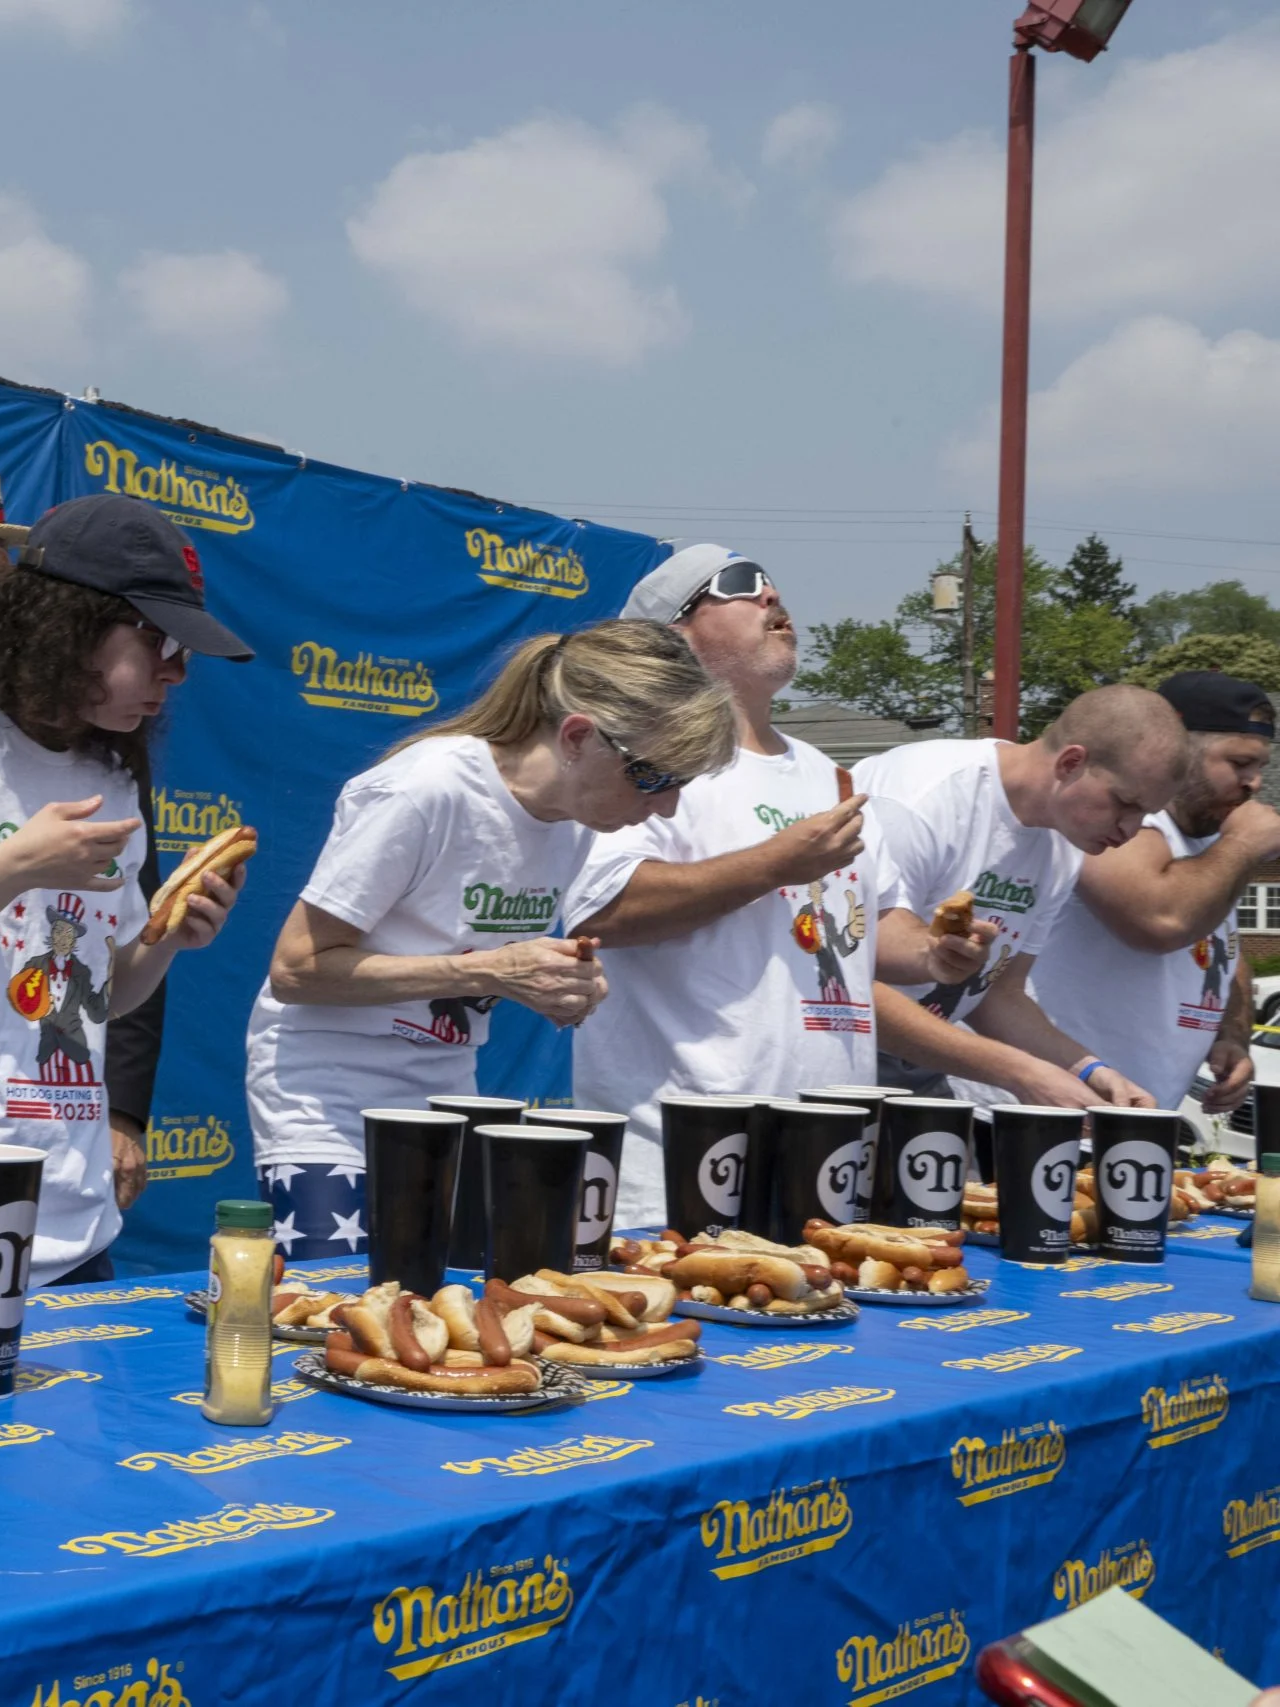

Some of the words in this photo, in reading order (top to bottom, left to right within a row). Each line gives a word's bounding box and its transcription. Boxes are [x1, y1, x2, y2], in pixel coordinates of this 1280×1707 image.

[85, 440, 248, 520] Nathan's
[465, 528, 585, 586] Nathan's
[291, 641, 434, 702] Nathan's
[342, 700, 391, 712] FAMOUS
[6, 1087, 28, 1098] HOT
[30, 1088, 52, 1099] DOG
[54, 1089, 92, 1100] EATING
[53, 1103, 96, 1120] 2023
[950, 1419, 1065, 1489] Nathan's
[59, 1503, 317, 1554] Nathan's
[700, 1477, 848, 1559] Nathan's
[490, 1563, 514, 1578] Since
[758, 1546, 804, 1568] FAMOUS
[1053, 1538, 1154, 1609] Nathan's
[373, 1554, 569, 1657] Nathan's
[444, 1634, 506, 1663] FAMOUS
[836, 1608, 966, 1693] Nathan's
[73, 1672, 106, 1690] Since
[107, 1663, 133, 1681] 1916
